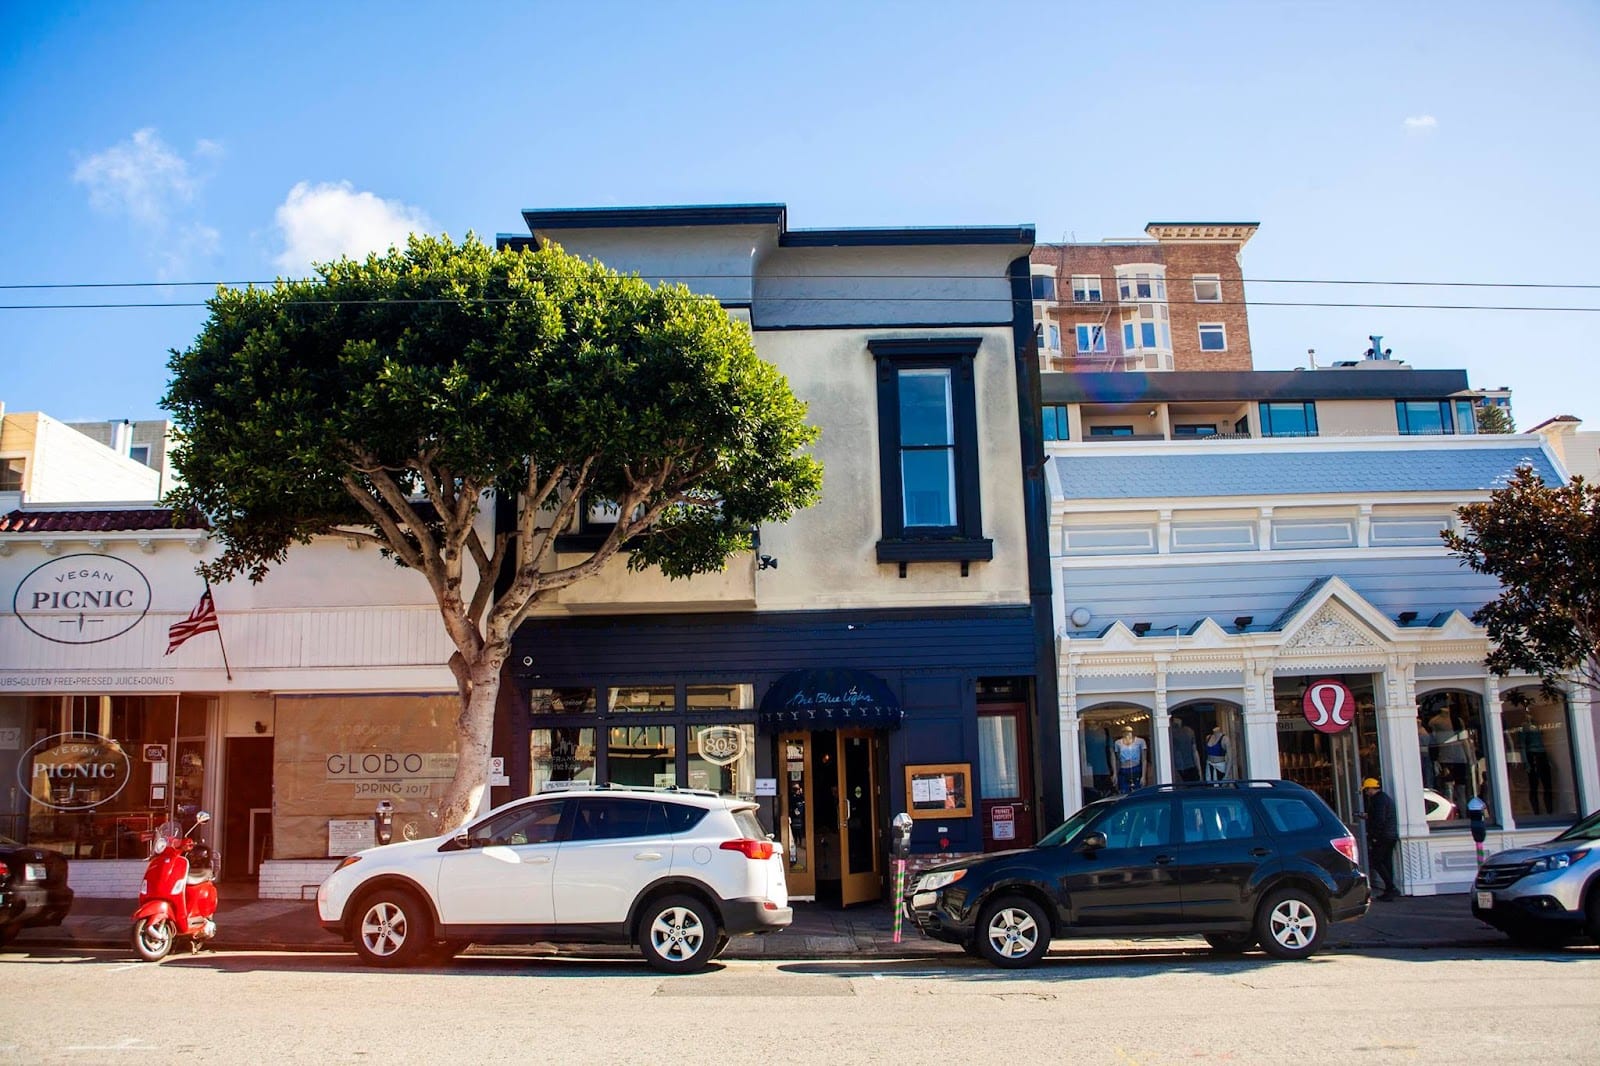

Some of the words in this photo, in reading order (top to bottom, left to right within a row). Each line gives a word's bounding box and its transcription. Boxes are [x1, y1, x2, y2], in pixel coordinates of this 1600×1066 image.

[55, 569, 114, 583] VEGAN
[31, 589, 134, 610] PICNIC
[0, 677, 18, 687] UBS
[815, 692, 841, 704] Blue
[52, 745, 100, 757] VEGAN
[705, 738, 738, 752] 805
[32, 762, 116, 779] PICNIC
[327, 753, 423, 774] GLOBO
[355, 783, 402, 794] SPRING
[405, 784, 430, 794] 2017
